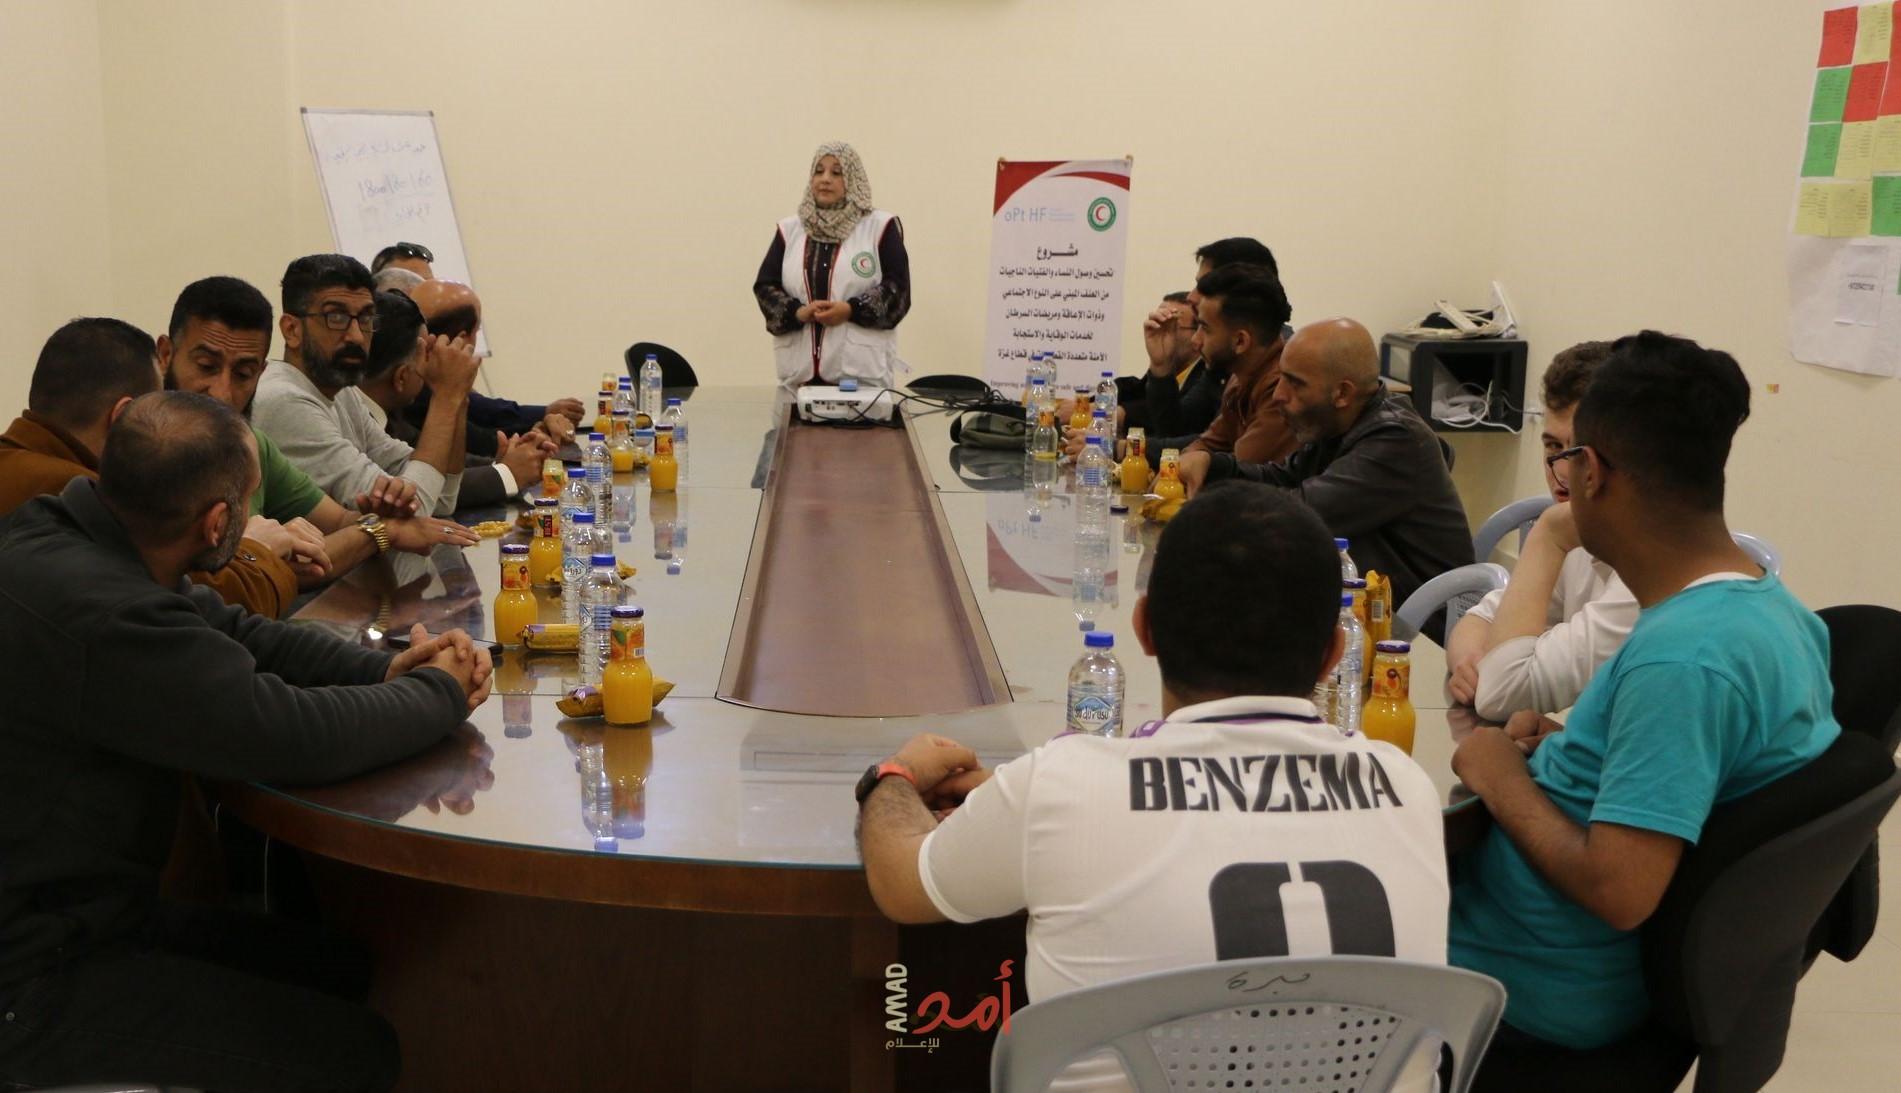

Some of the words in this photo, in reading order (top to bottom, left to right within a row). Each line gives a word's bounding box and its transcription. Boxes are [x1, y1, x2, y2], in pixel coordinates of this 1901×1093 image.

[1029, 207, 1047, 223] HF
[1037, 243, 1078, 260] مشروع
[1055, 266, 1074, 277] النساء
[1002, 286, 1033, 300] الاجتماعي
[1034, 287, 1049, 300] النوع
[1050, 288, 1062, 300] على
[1081, 288, 1100, 298] العنف
[1129, 751, 1404, 812] BENZEMA
